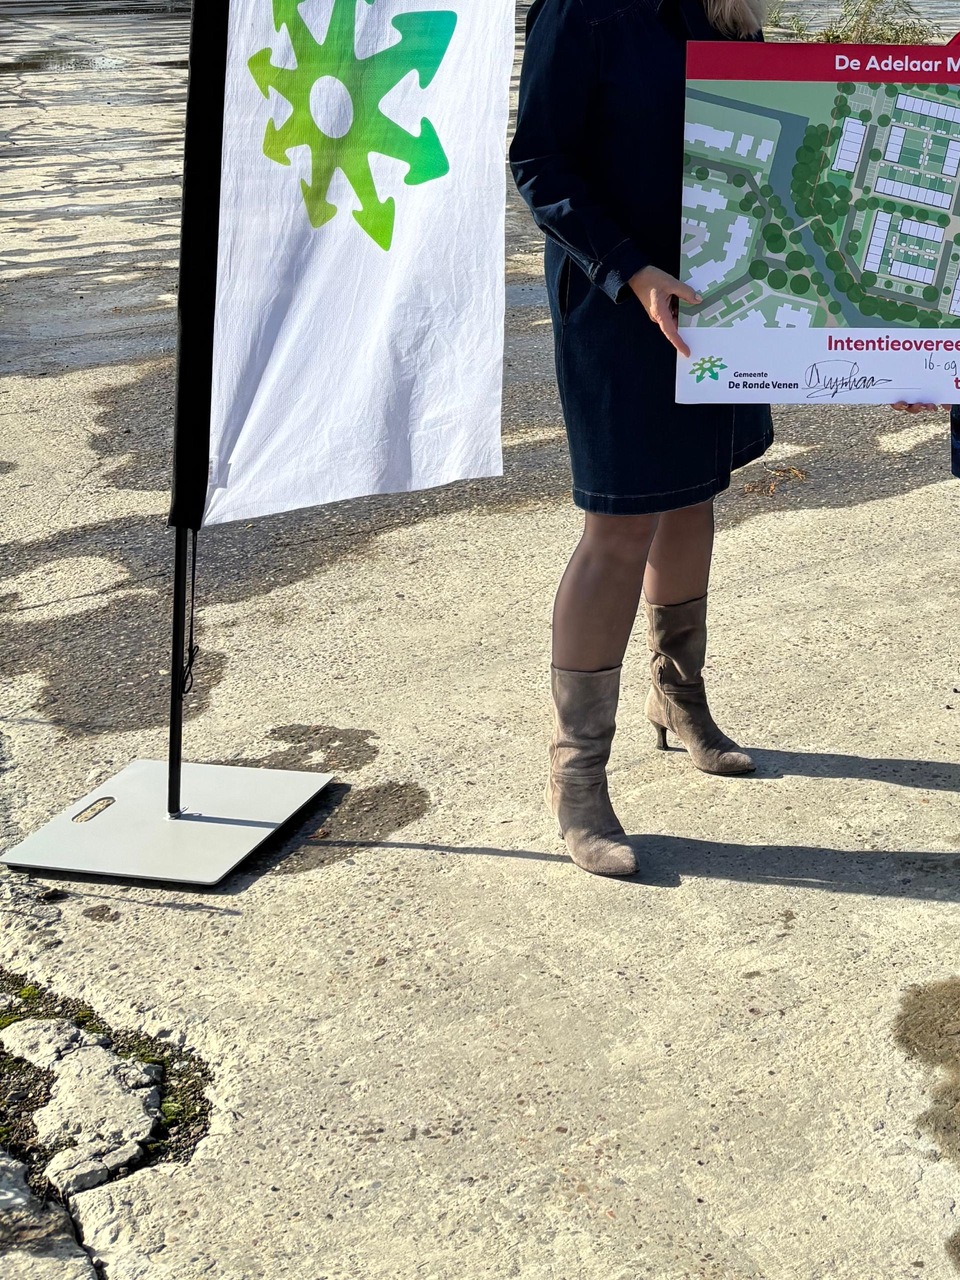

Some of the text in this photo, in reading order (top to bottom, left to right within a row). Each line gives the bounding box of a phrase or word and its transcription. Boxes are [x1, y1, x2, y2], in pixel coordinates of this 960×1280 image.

[835, 54, 860, 71] De
[865, 55, 942, 73] Adelaar
[728, 380, 799, 389] De Ronde Venen
